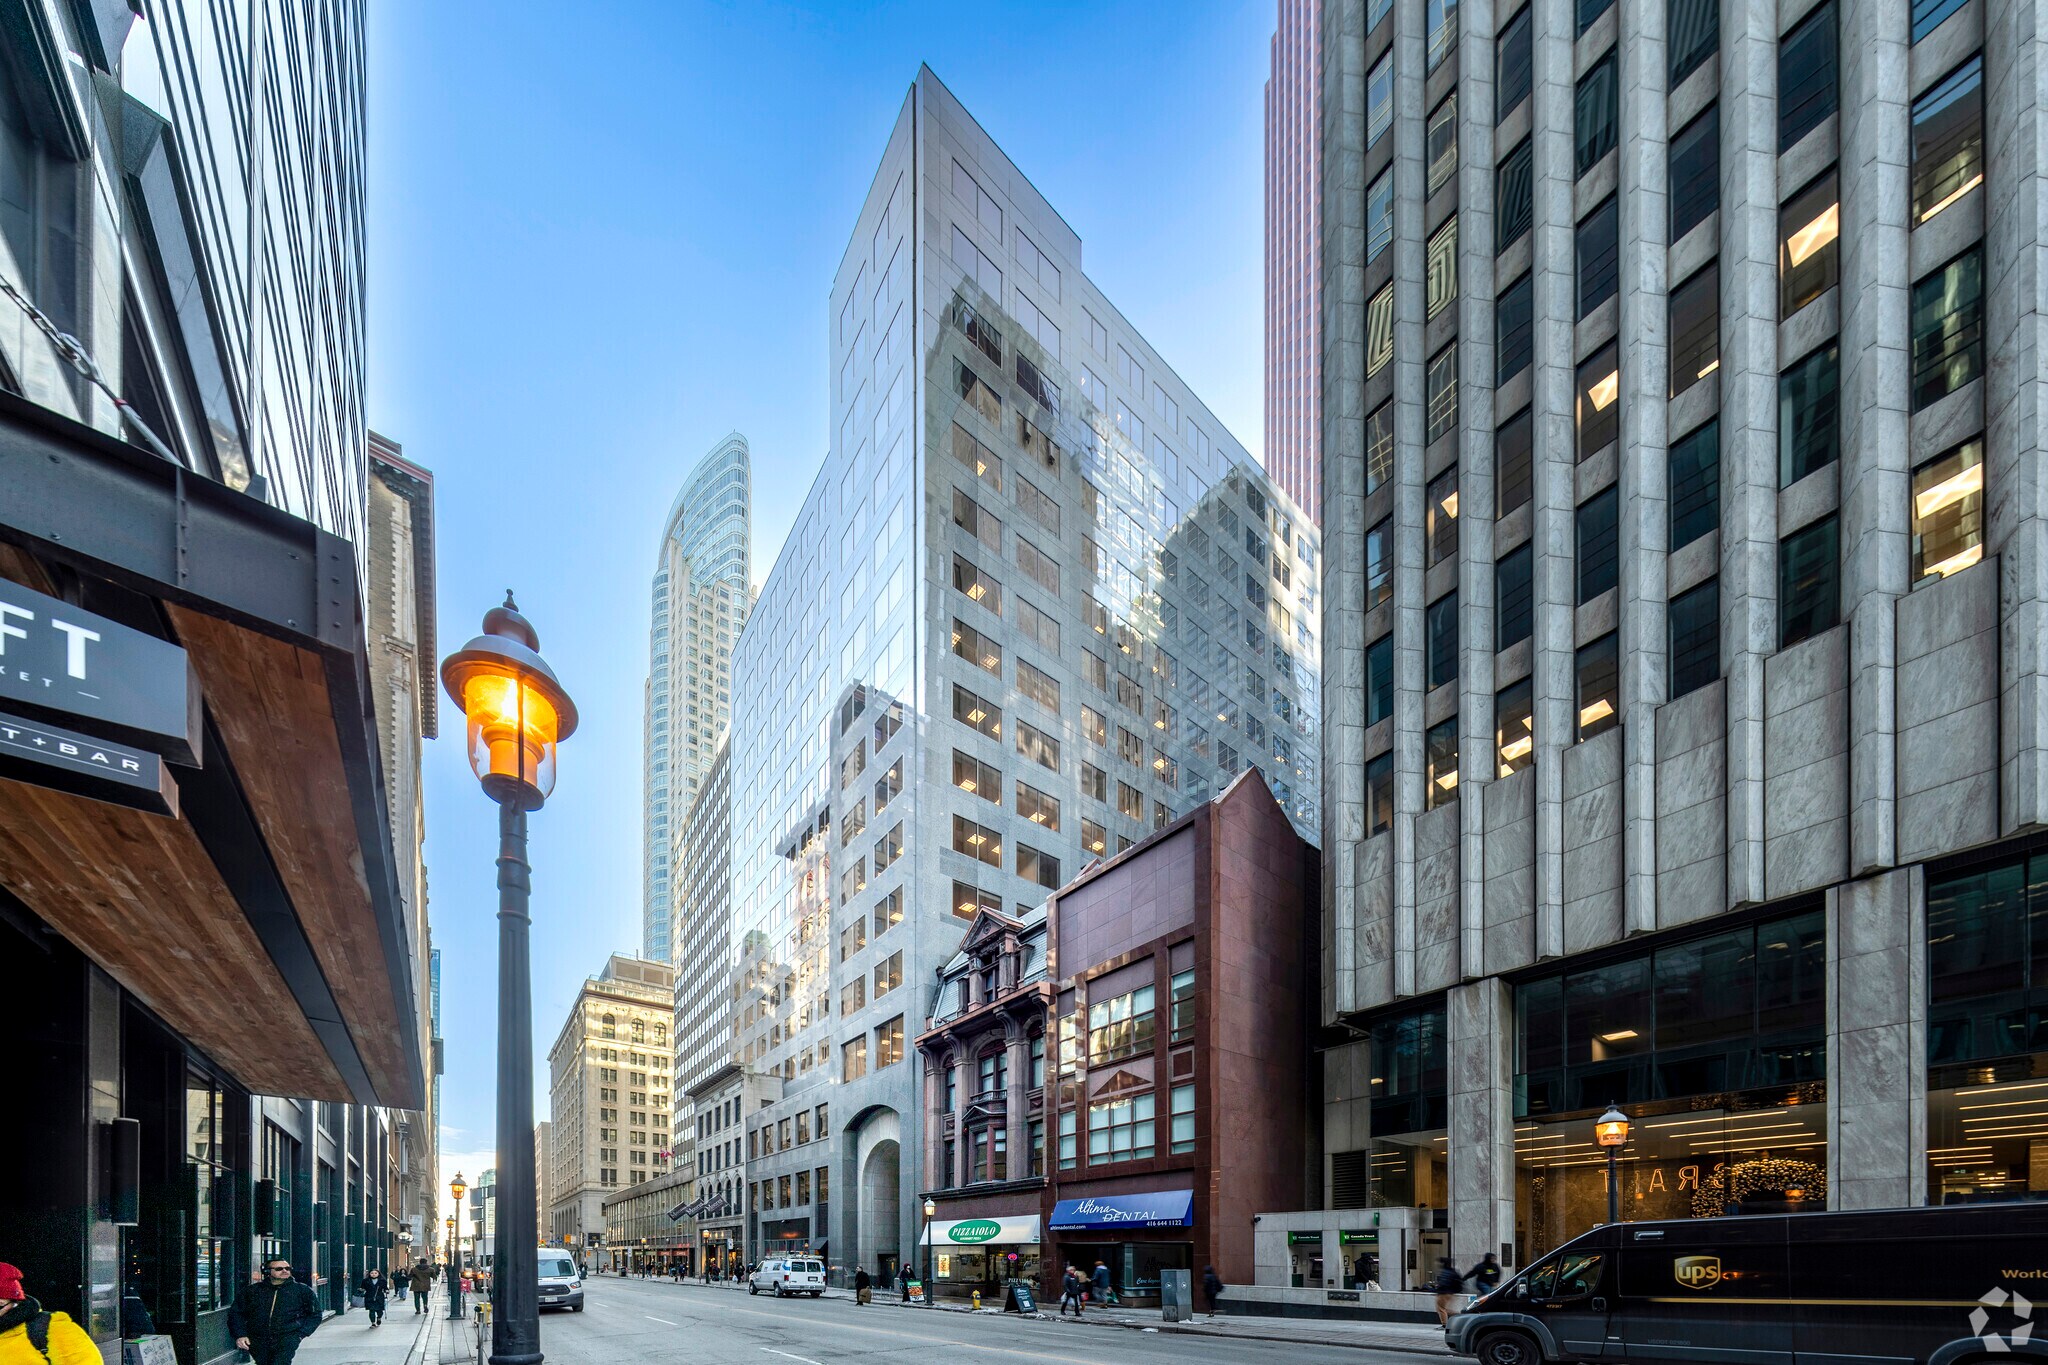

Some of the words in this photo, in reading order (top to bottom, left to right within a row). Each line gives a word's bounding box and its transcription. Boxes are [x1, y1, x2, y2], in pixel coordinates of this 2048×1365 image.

[1072, 1199, 1121, 1214] Altima
[1102, 1210, 1158, 1222] DENTAL
[952, 1226, 997, 1237] PIZZAIOLO
[1677, 1265, 1718, 1285] ups
